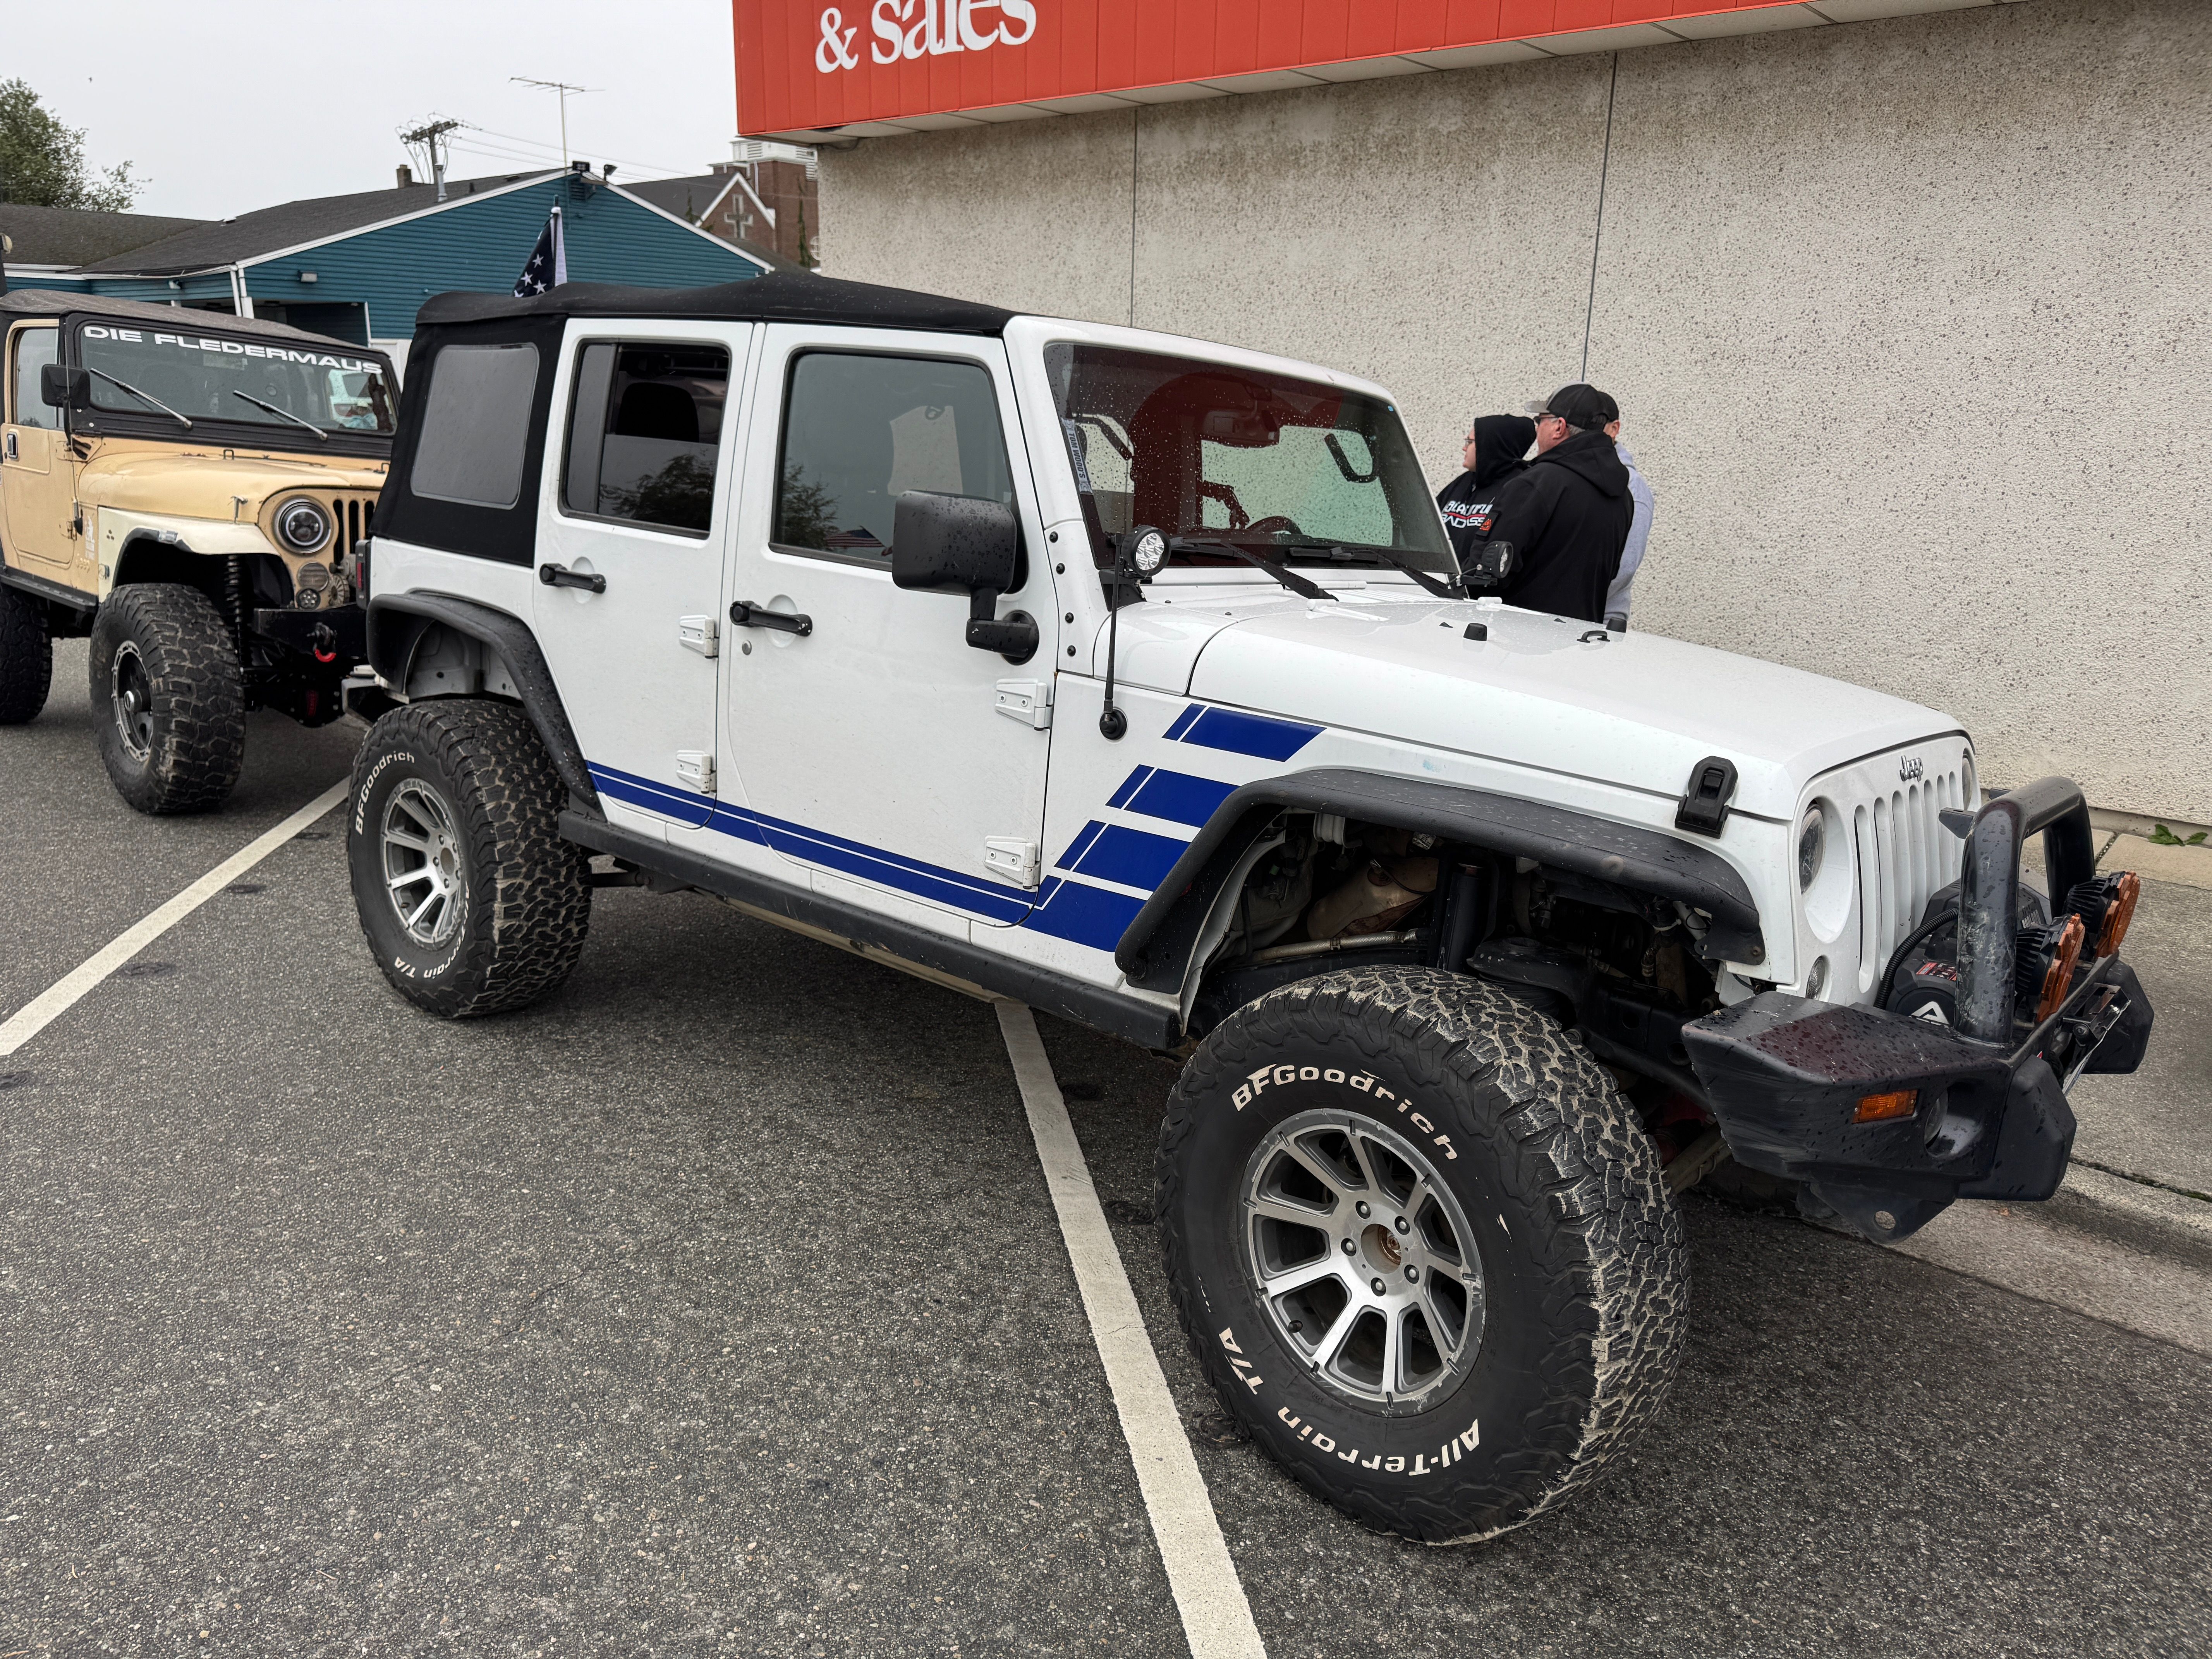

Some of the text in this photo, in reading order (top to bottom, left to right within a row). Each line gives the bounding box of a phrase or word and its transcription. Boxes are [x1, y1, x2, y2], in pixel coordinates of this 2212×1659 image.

[816, 0, 1036, 73] & sales
[84, 326, 143, 343] DIE
[155, 334, 384, 374] FLEDERMAUS
[1069, 433, 1086, 479] TOM WOOD'S
[355, 751, 415, 835] BFGoodrich
[1900, 755, 1923, 782] Jeep
[394, 957, 415, 978] T/A
[1231, 1063, 1457, 1160] BFGoodrich
[1219, 1327, 1480, 1476] All-Terrain T/A
